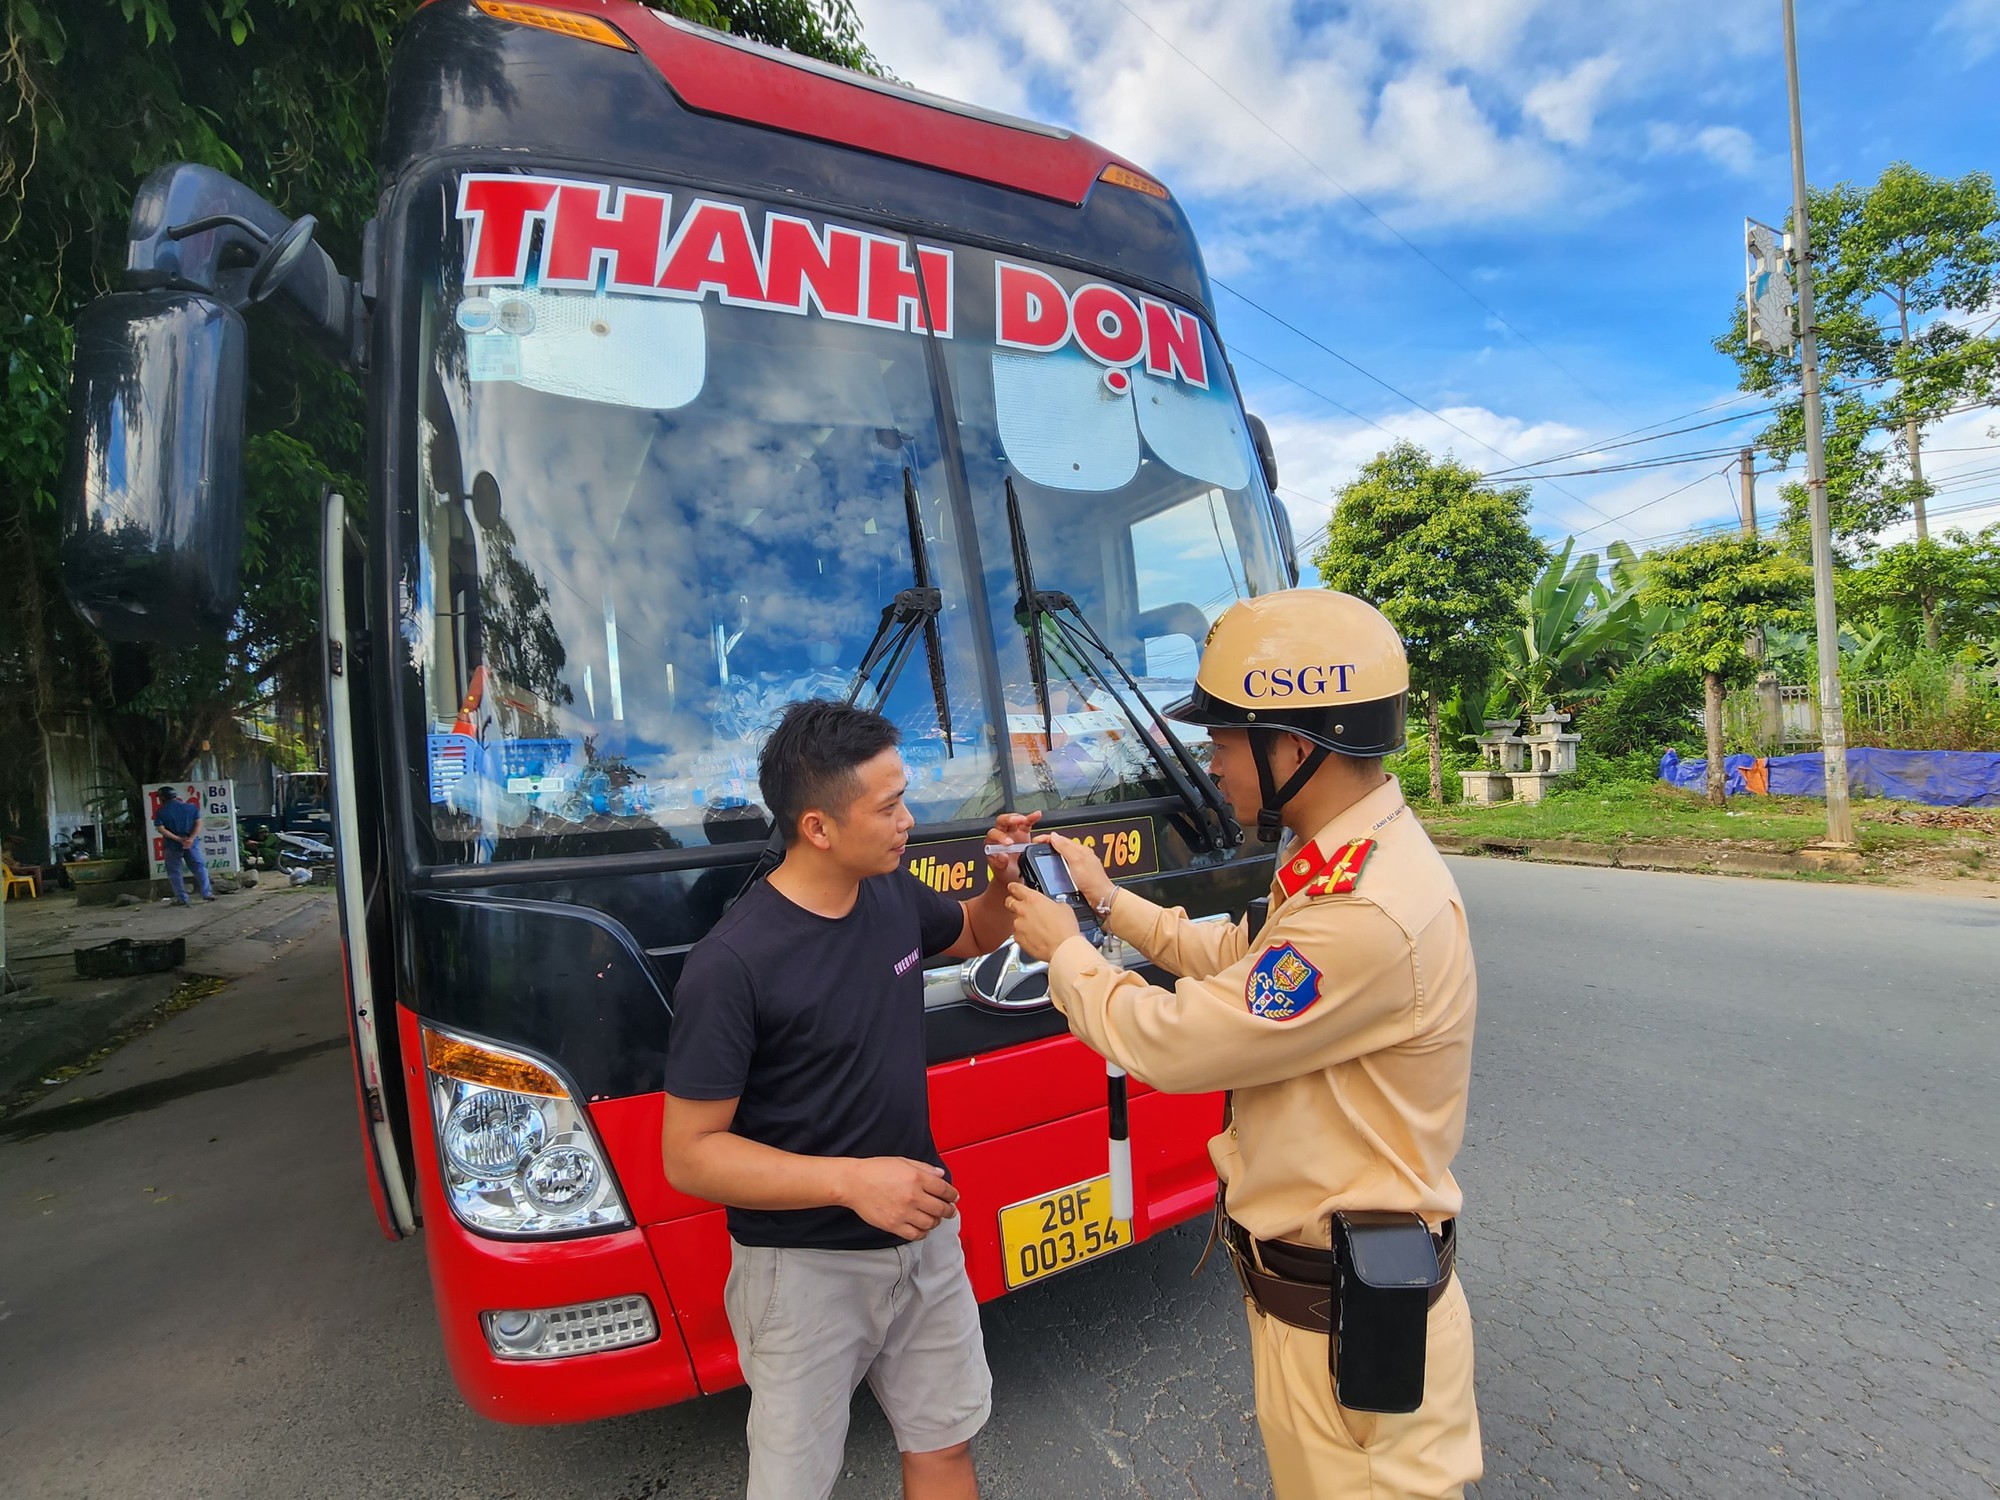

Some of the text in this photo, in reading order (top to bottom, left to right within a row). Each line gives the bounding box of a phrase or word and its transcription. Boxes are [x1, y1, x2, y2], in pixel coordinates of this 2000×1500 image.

[455, 173, 1209, 394] THANH DỌN
[1244, 664, 1356, 698] CSGT
[208, 785, 226, 797] Bò
[210, 802, 228, 814] Gà
[1102, 829, 1141, 867] 769
[1257, 972, 1273, 990] CS
[1275, 991, 1294, 1008] GT
[1039, 1188, 1091, 1233] 28F
[1021, 1216, 1118, 1277] 003.54
